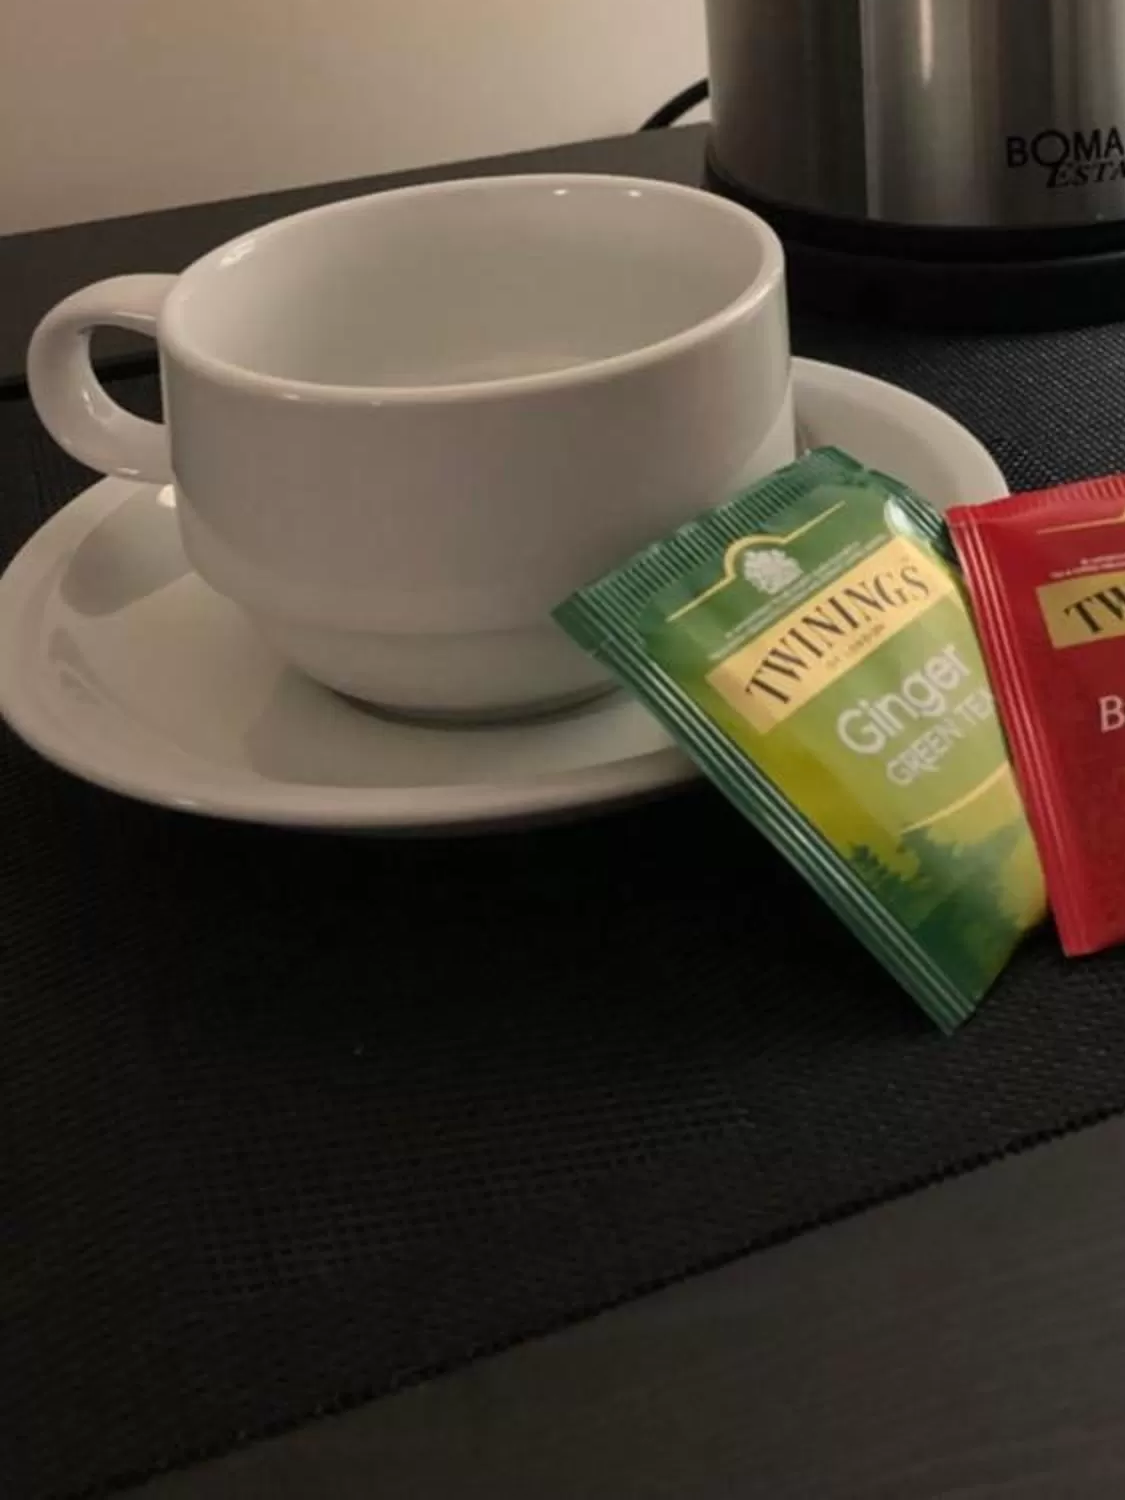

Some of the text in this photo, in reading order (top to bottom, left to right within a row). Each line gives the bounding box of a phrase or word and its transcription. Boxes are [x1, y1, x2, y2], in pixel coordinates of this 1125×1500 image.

[745, 564, 930, 705] TWININGS
[837, 644, 971, 754] Ginger
[886, 718, 966, 787] GREEN
